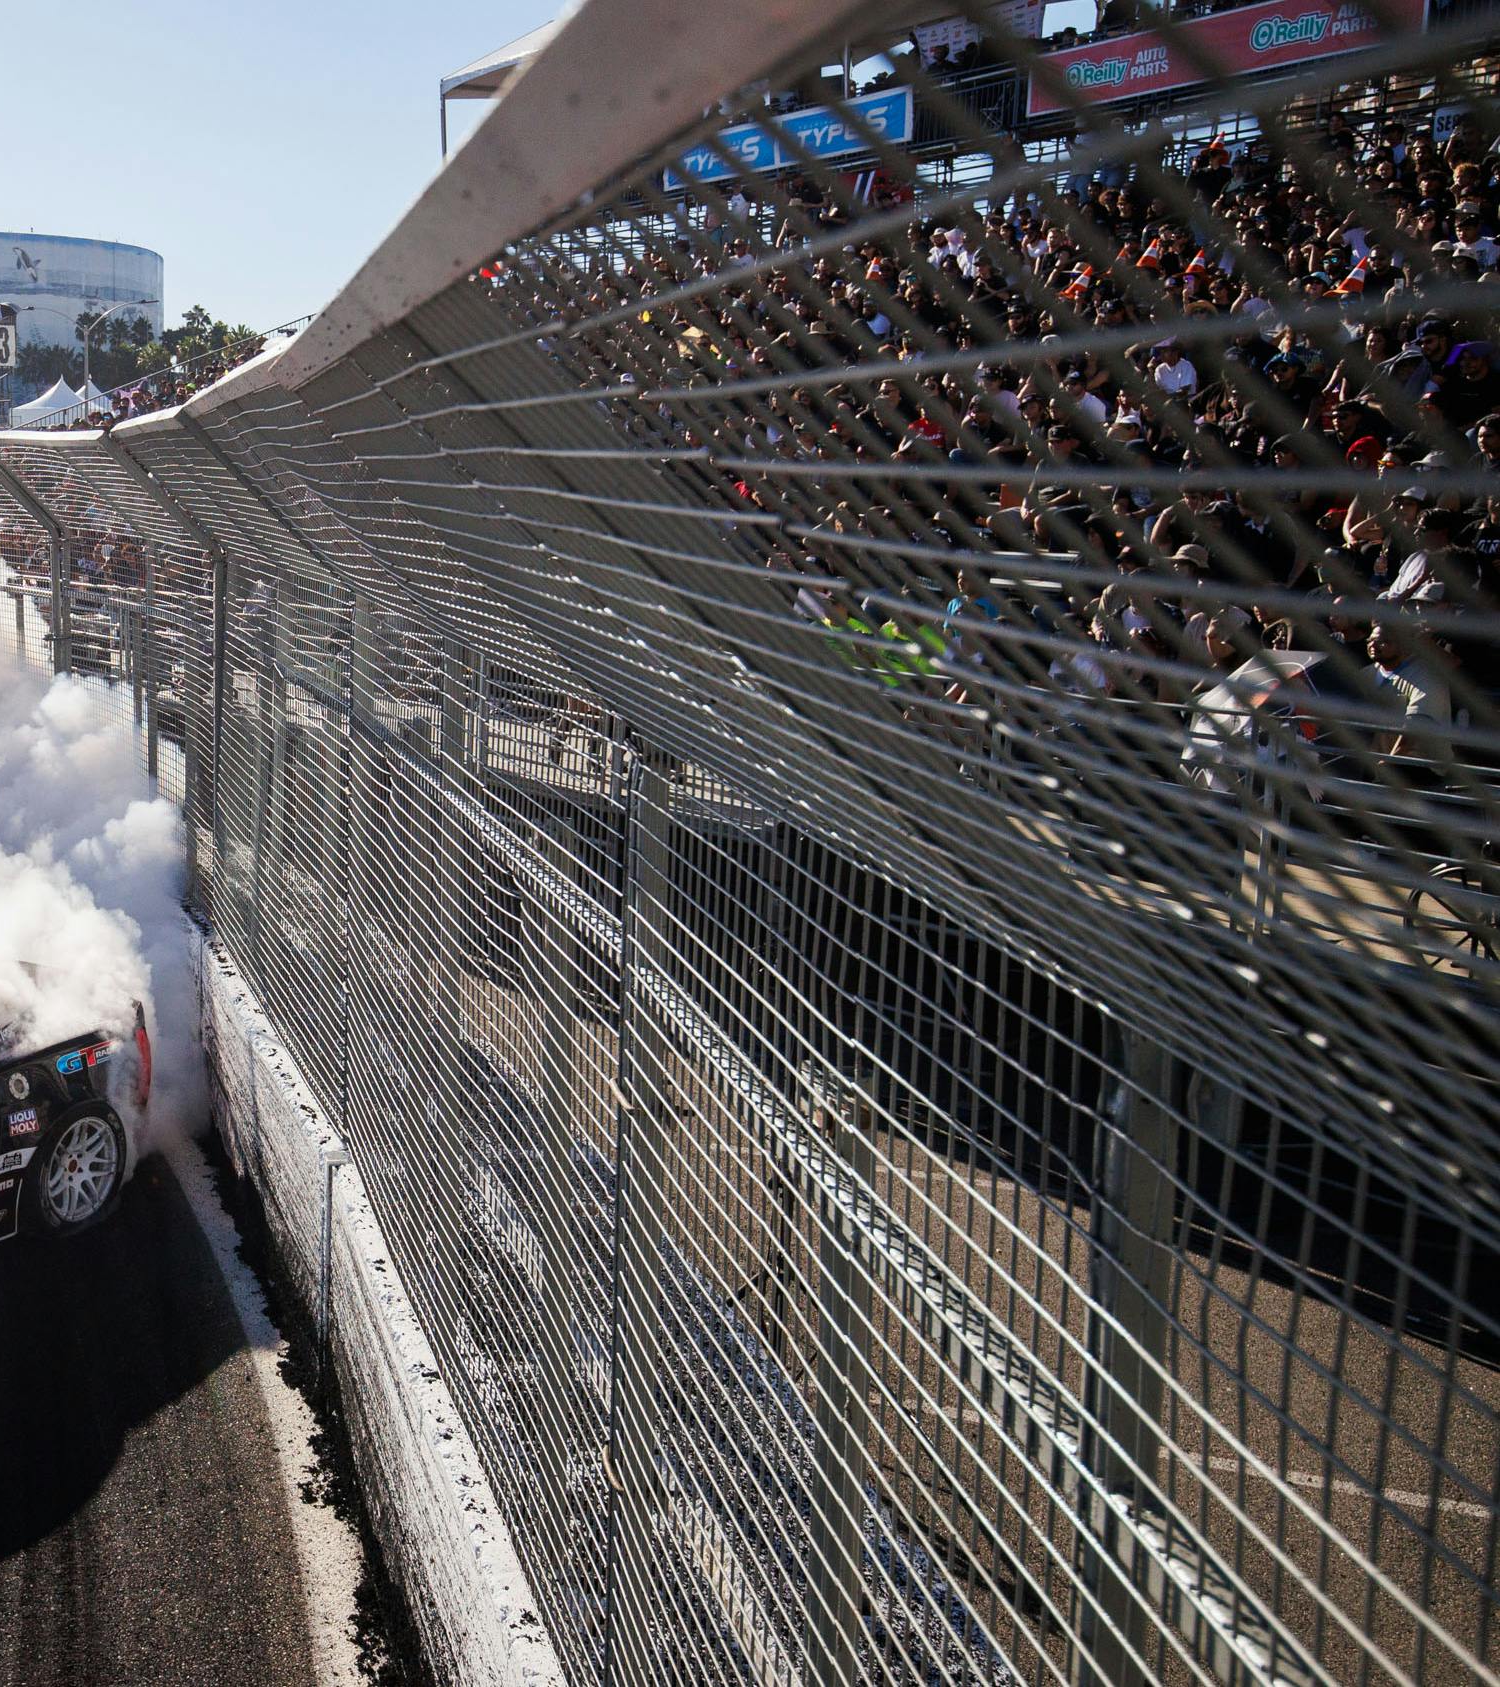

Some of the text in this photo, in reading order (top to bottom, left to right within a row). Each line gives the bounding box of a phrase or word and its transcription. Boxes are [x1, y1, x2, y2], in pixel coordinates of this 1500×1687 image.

[1251, 11, 1332, 50] O'Reilly
[1135, 46, 1167, 64] AUTO
[1065, 58, 1131, 88] O'Reilly
[1130, 60, 1169, 80] PARTS
[865, 105, 889, 132] S
[741, 136, 762, 162] S
[9, 1111, 36, 1125] LIQUI
[10, 1121, 37, 1135] MOLY
